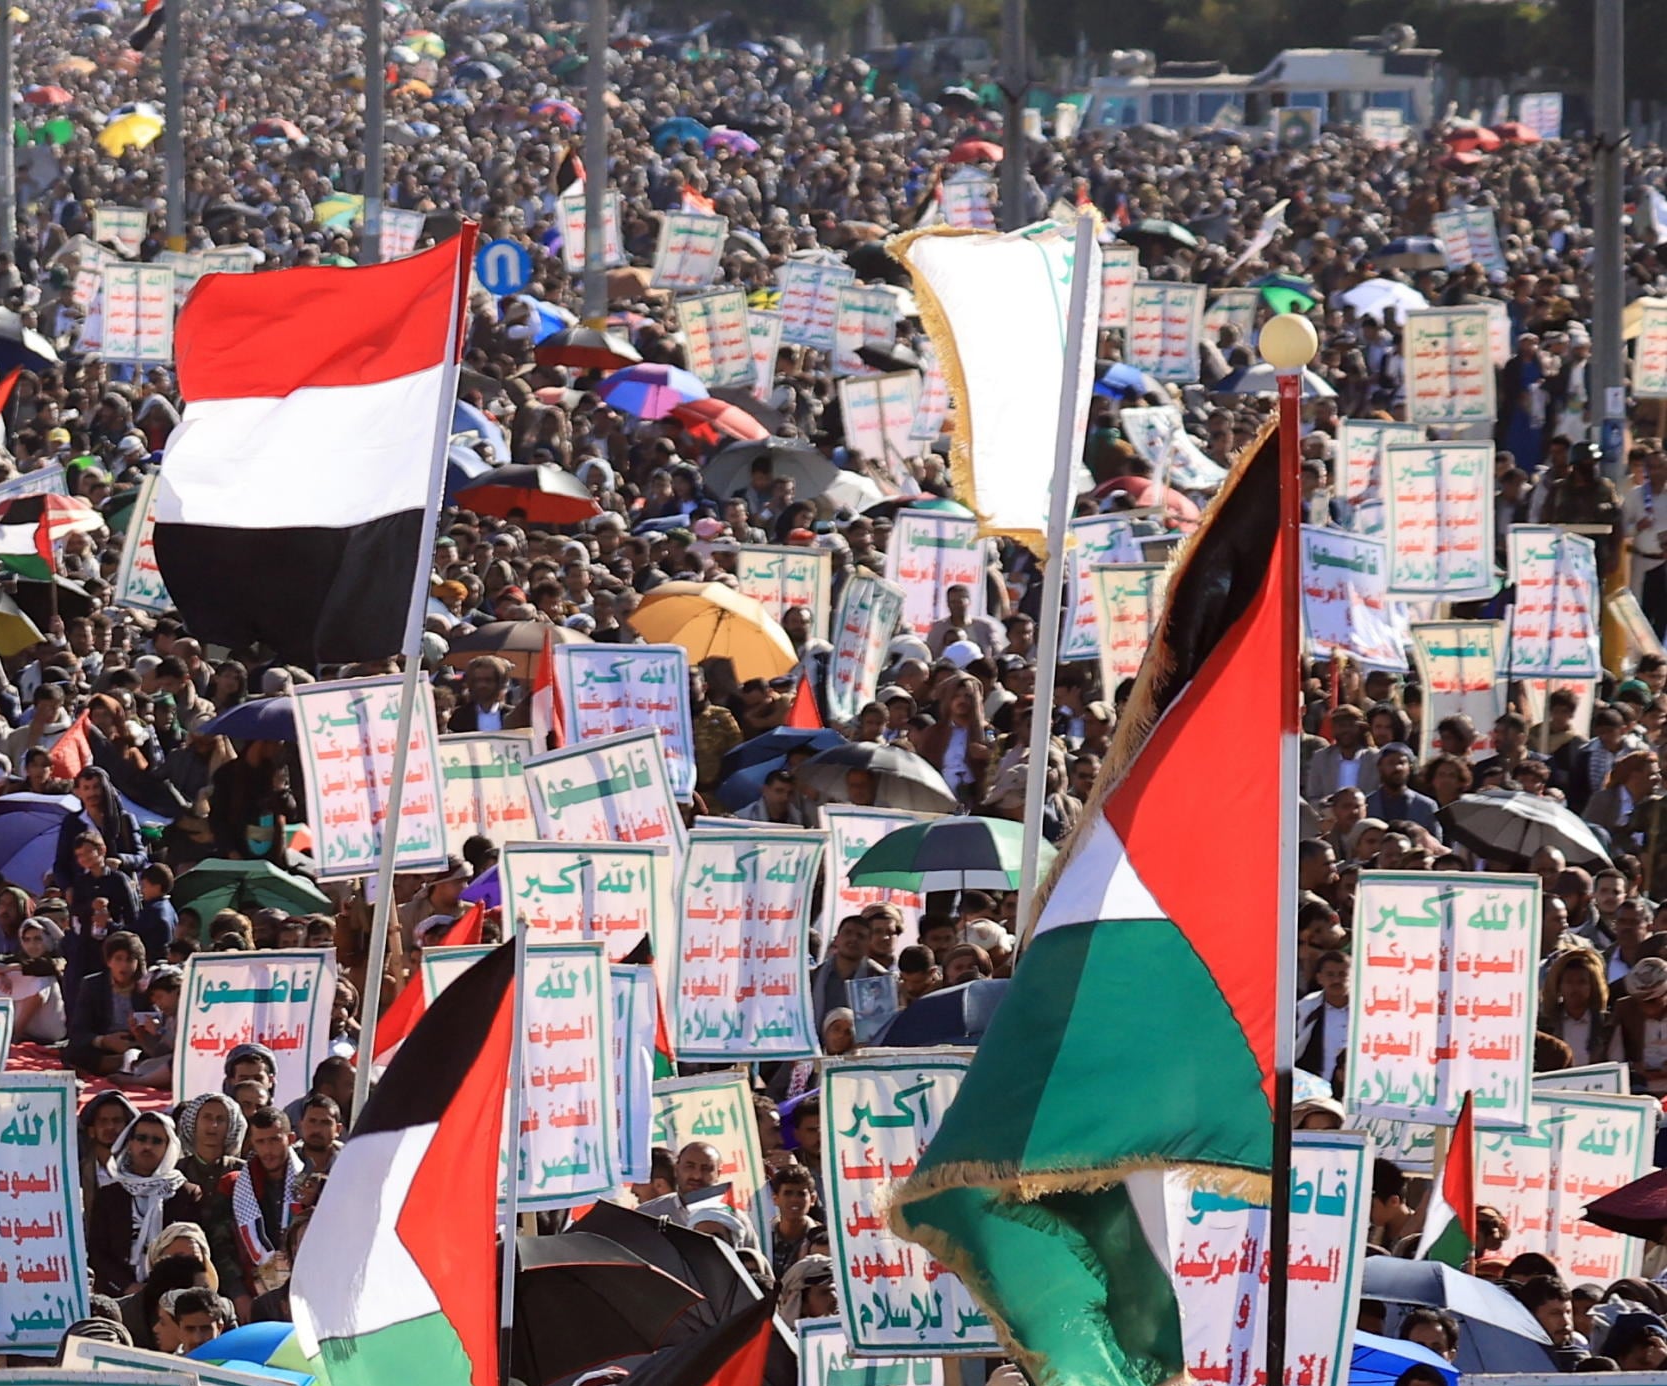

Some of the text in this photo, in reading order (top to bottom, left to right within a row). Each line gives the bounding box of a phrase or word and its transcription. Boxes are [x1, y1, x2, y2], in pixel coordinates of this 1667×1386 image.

[0, 1102, 58, 1146] الله
[838, 1073, 935, 1143] أكبر
[16, 1255, 69, 1284] اللعنة
[851, 1248, 914, 1285] اليهود
[5, 1292, 74, 1342] النصر
